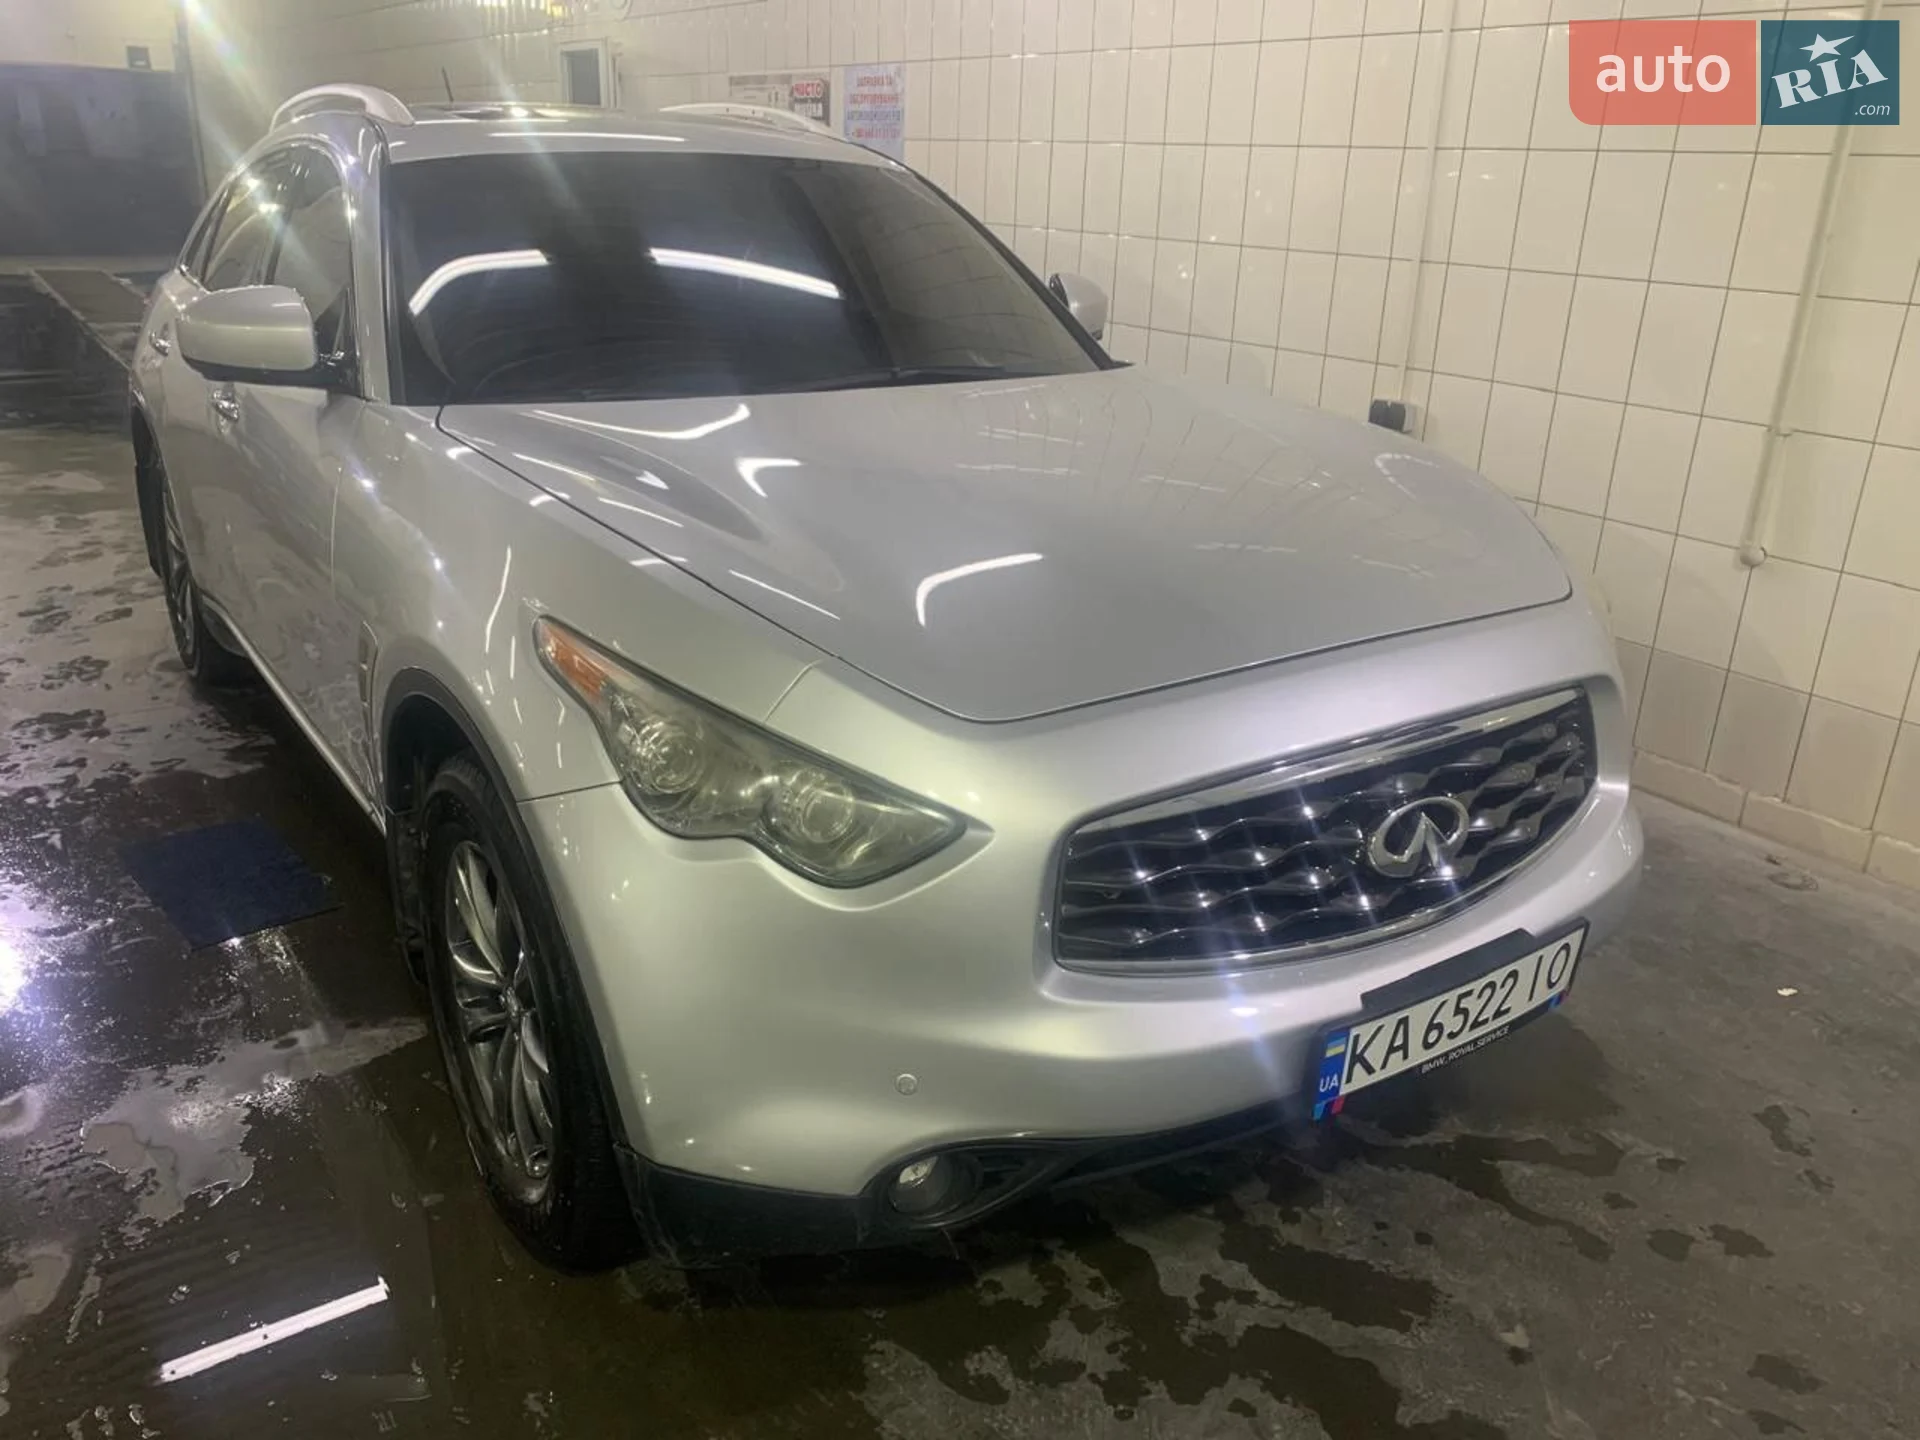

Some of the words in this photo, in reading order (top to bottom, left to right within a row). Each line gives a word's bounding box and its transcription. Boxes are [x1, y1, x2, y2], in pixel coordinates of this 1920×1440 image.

[1344, 1015, 1410, 1084] KA
[1422, 969, 1519, 1051] 6522
[1319, 1073, 1339, 1092] UA
